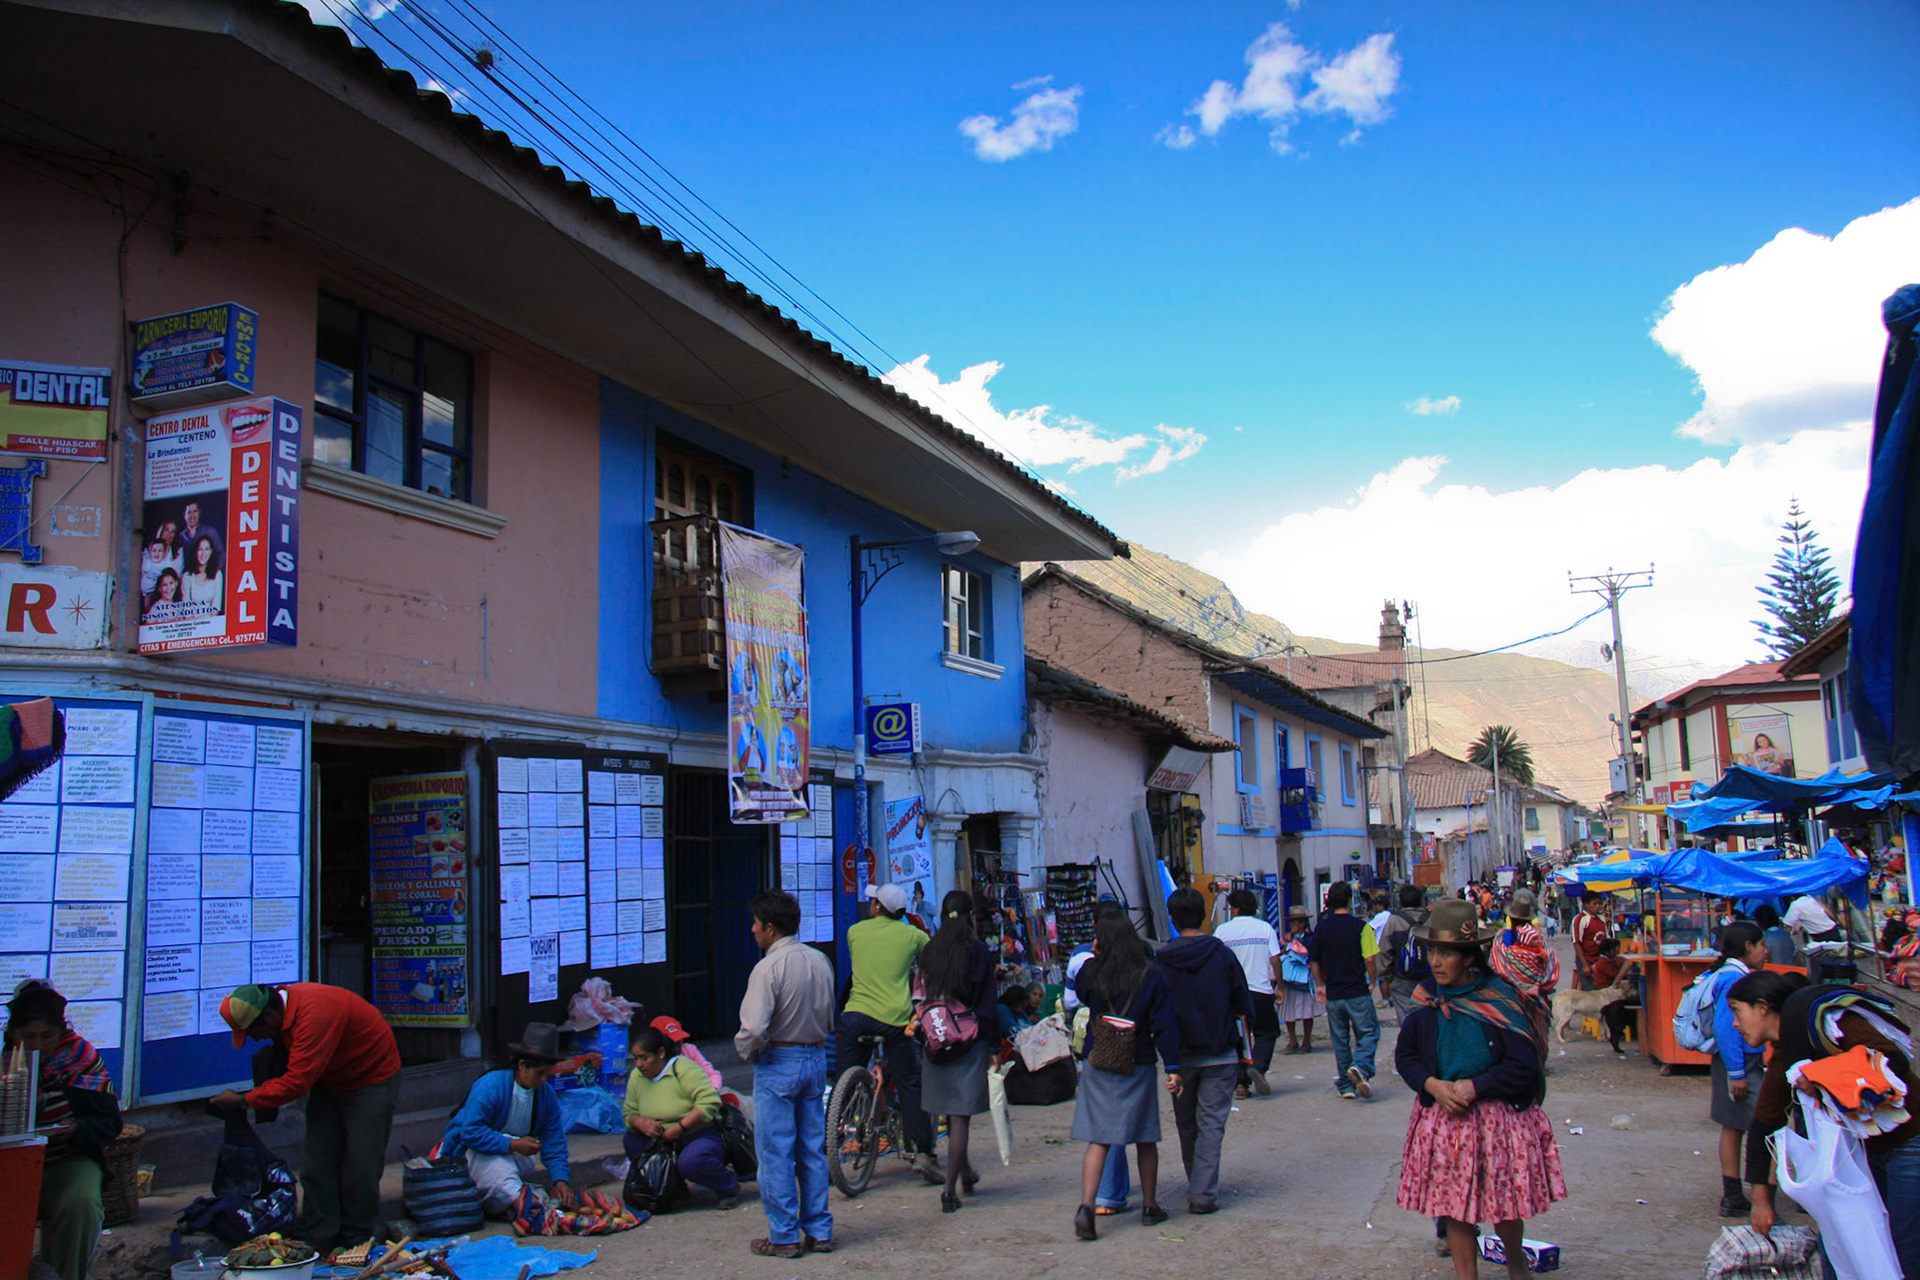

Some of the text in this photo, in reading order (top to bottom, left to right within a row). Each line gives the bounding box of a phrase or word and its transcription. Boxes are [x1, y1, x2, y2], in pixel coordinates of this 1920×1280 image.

[190, 307, 228, 335] EMPORIO
[192, 342, 222, 350] Huascar
[233, 312, 254, 383] EMPORIO
[15, 371, 109, 406] DENTAL
[150, 415, 209, 437] CENTRO DENTAL
[19, 437, 97, 448] CALLE HUASCAR
[178, 429, 216, 444] CENTENO
[157, 447, 192, 457] Brindamos:
[272, 412, 299, 630] DENTISTA
[237, 451, 261, 623] DENTAL
[6, 582, 58, 634] R
[178, 607, 219, 616] ADULTOS
[140, 643, 159, 652] CITAS
[160, 642, 165, 650] Y
[167, 638, 217, 649] EMERGENCIAS:
[235, 632, 265, 643] 9757743
[425, 777, 464, 794] EMPORIO
[373, 814, 419, 825] CARNES
[374, 879, 462, 891] POLLOS Y GALLINAS
[398, 890, 441, 900] DE CORRAL
[374, 926, 435, 935] PESCADO
[379, 936, 430, 945] FRESCO
[530, 938, 556, 956] YOGURT
